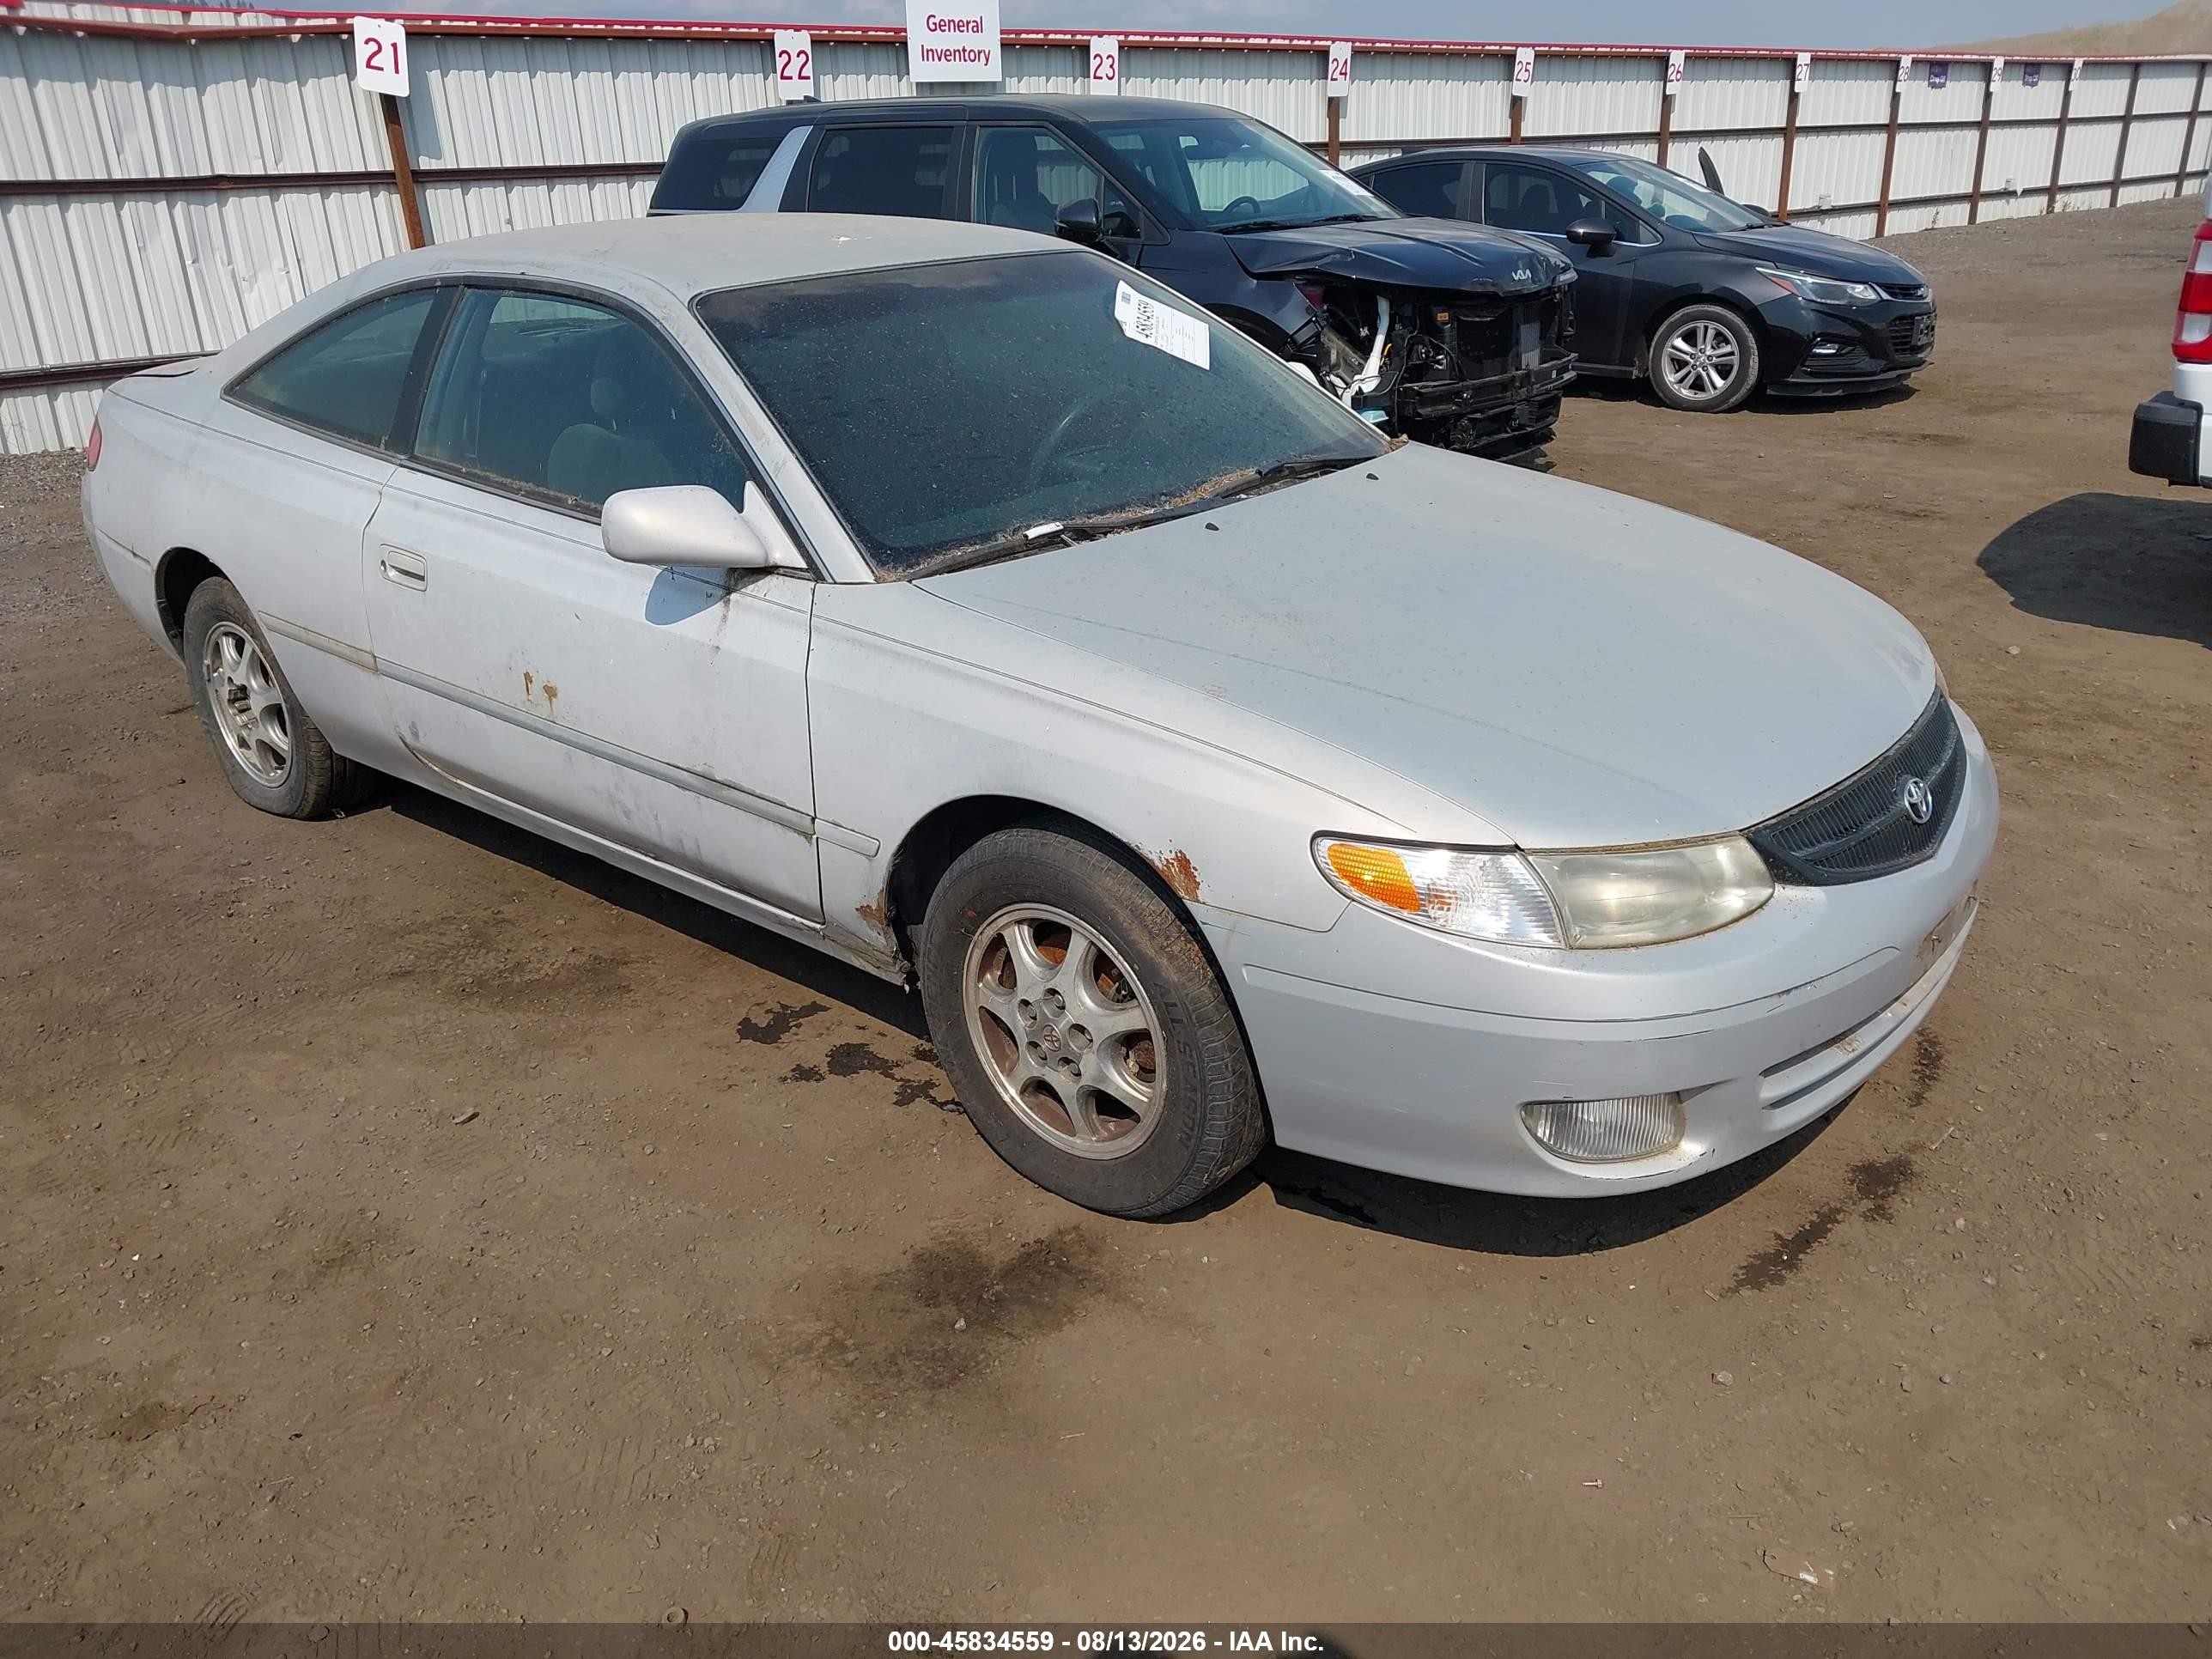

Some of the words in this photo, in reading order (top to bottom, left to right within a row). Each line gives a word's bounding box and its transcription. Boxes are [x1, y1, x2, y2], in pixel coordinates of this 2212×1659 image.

[927, 14, 983, 33] General
[363, 37, 400, 75] 21
[778, 49, 811, 80] 22
[921, 44, 991, 66] Inventory
[1093, 53, 1115, 81] 23
[1330, 58, 1348, 82] 24
[1515, 60, 1531, 82] 25
[1667, 63, 1682, 82] 26
[1796, 63, 1810, 82] 27
[1898, 65, 1910, 82] 28
[1991, 67, 2002, 82] 29
